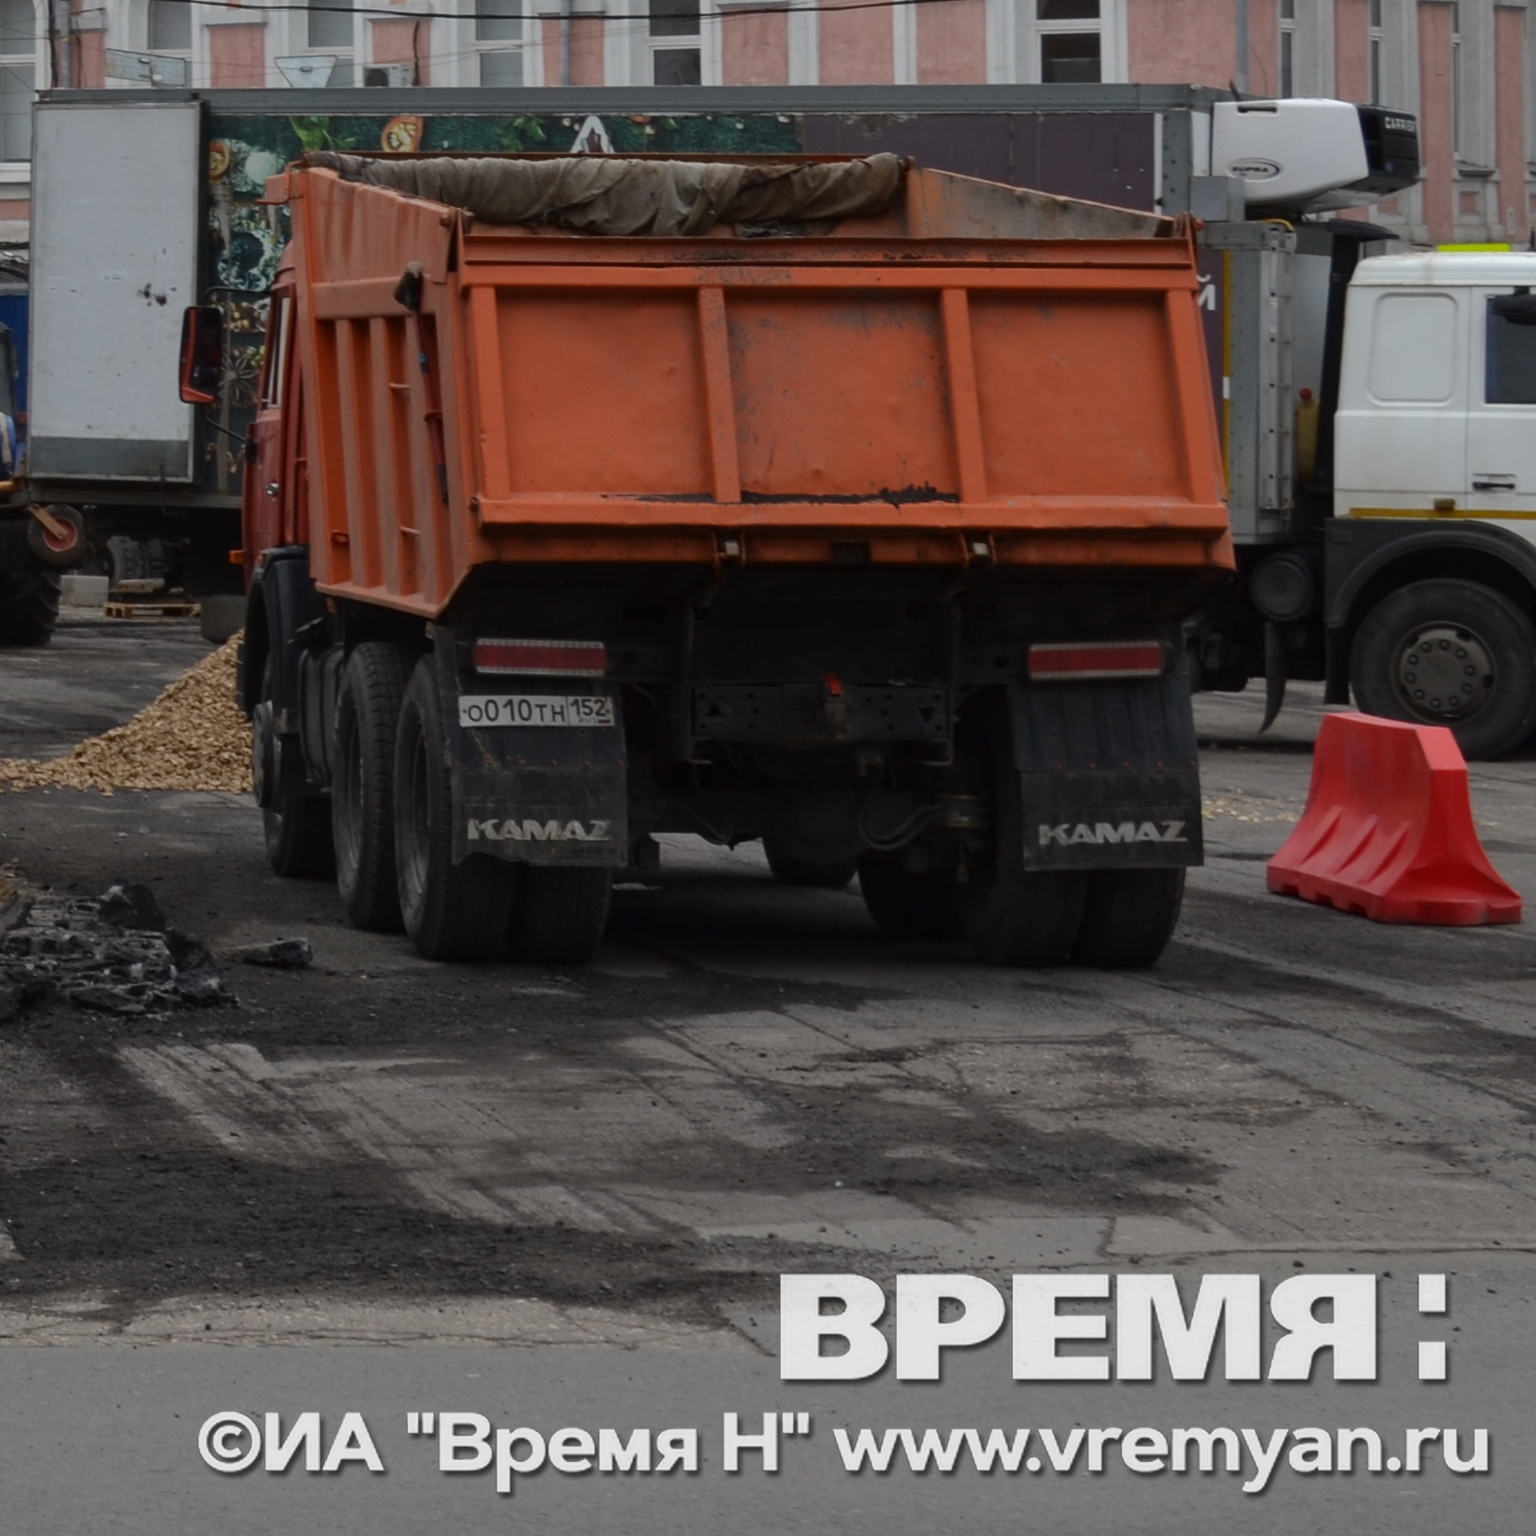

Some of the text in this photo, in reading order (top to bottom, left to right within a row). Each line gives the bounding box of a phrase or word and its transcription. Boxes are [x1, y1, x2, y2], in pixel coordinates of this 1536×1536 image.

[570, 698, 606, 716] 152
[467, 818, 611, 841] KAMAZ
[1038, 820, 1188, 847] KAMAZ
